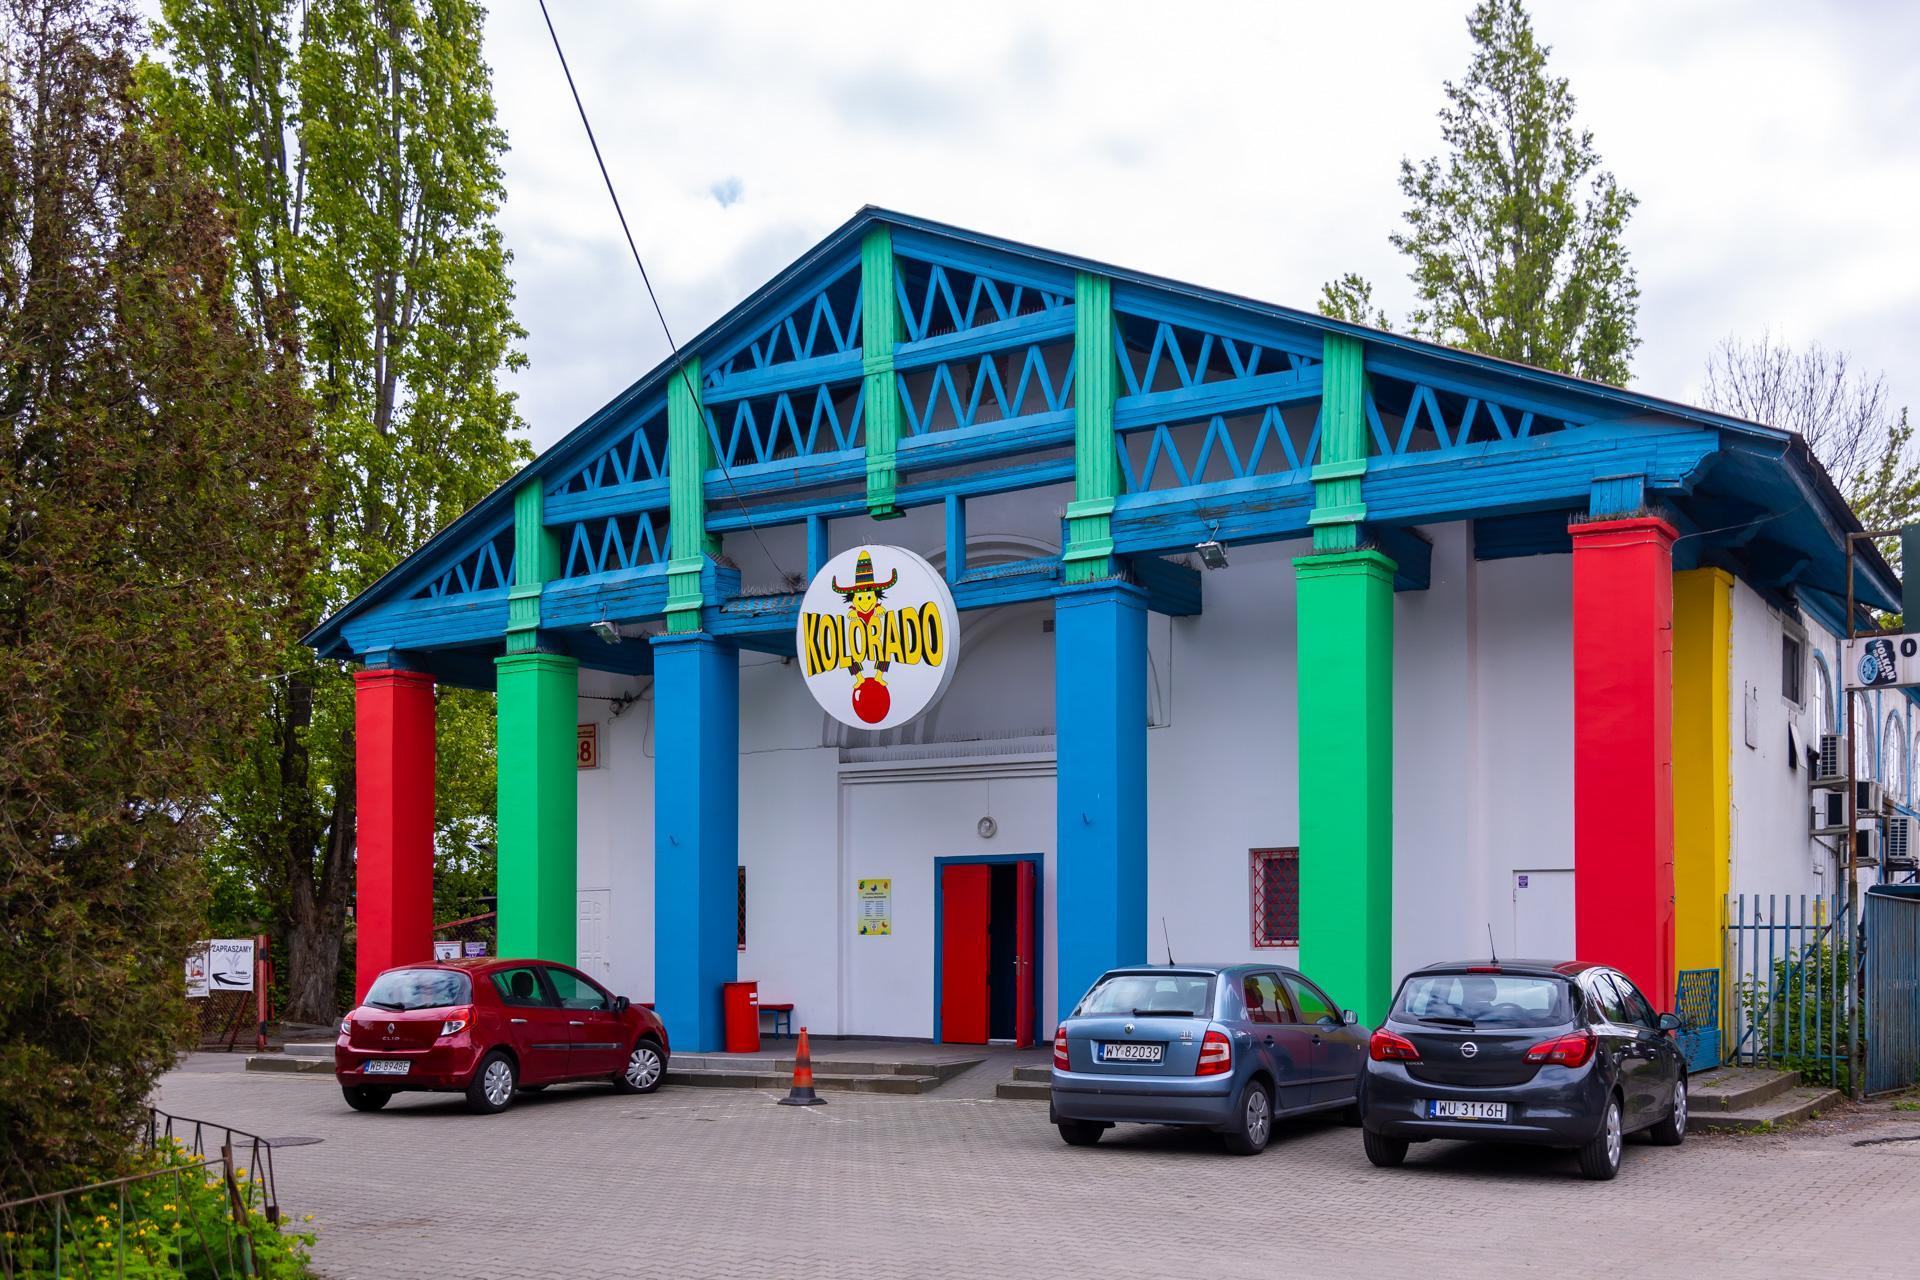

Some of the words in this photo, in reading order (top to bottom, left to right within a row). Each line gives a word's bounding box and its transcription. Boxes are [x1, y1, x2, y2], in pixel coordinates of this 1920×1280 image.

[802, 601, 943, 677] KOLORADO
[1875, 640, 1896, 680] VOLKAN
[212, 944, 252, 953] ZAPRASZAMY
[1106, 1046, 1121, 1057] WY
[1125, 1046, 1160, 1059] 82039
[370, 1061, 381, 1071] WB
[1439, 1102, 1457, 1115] WU
[1461, 1103, 1503, 1117] 3116H
